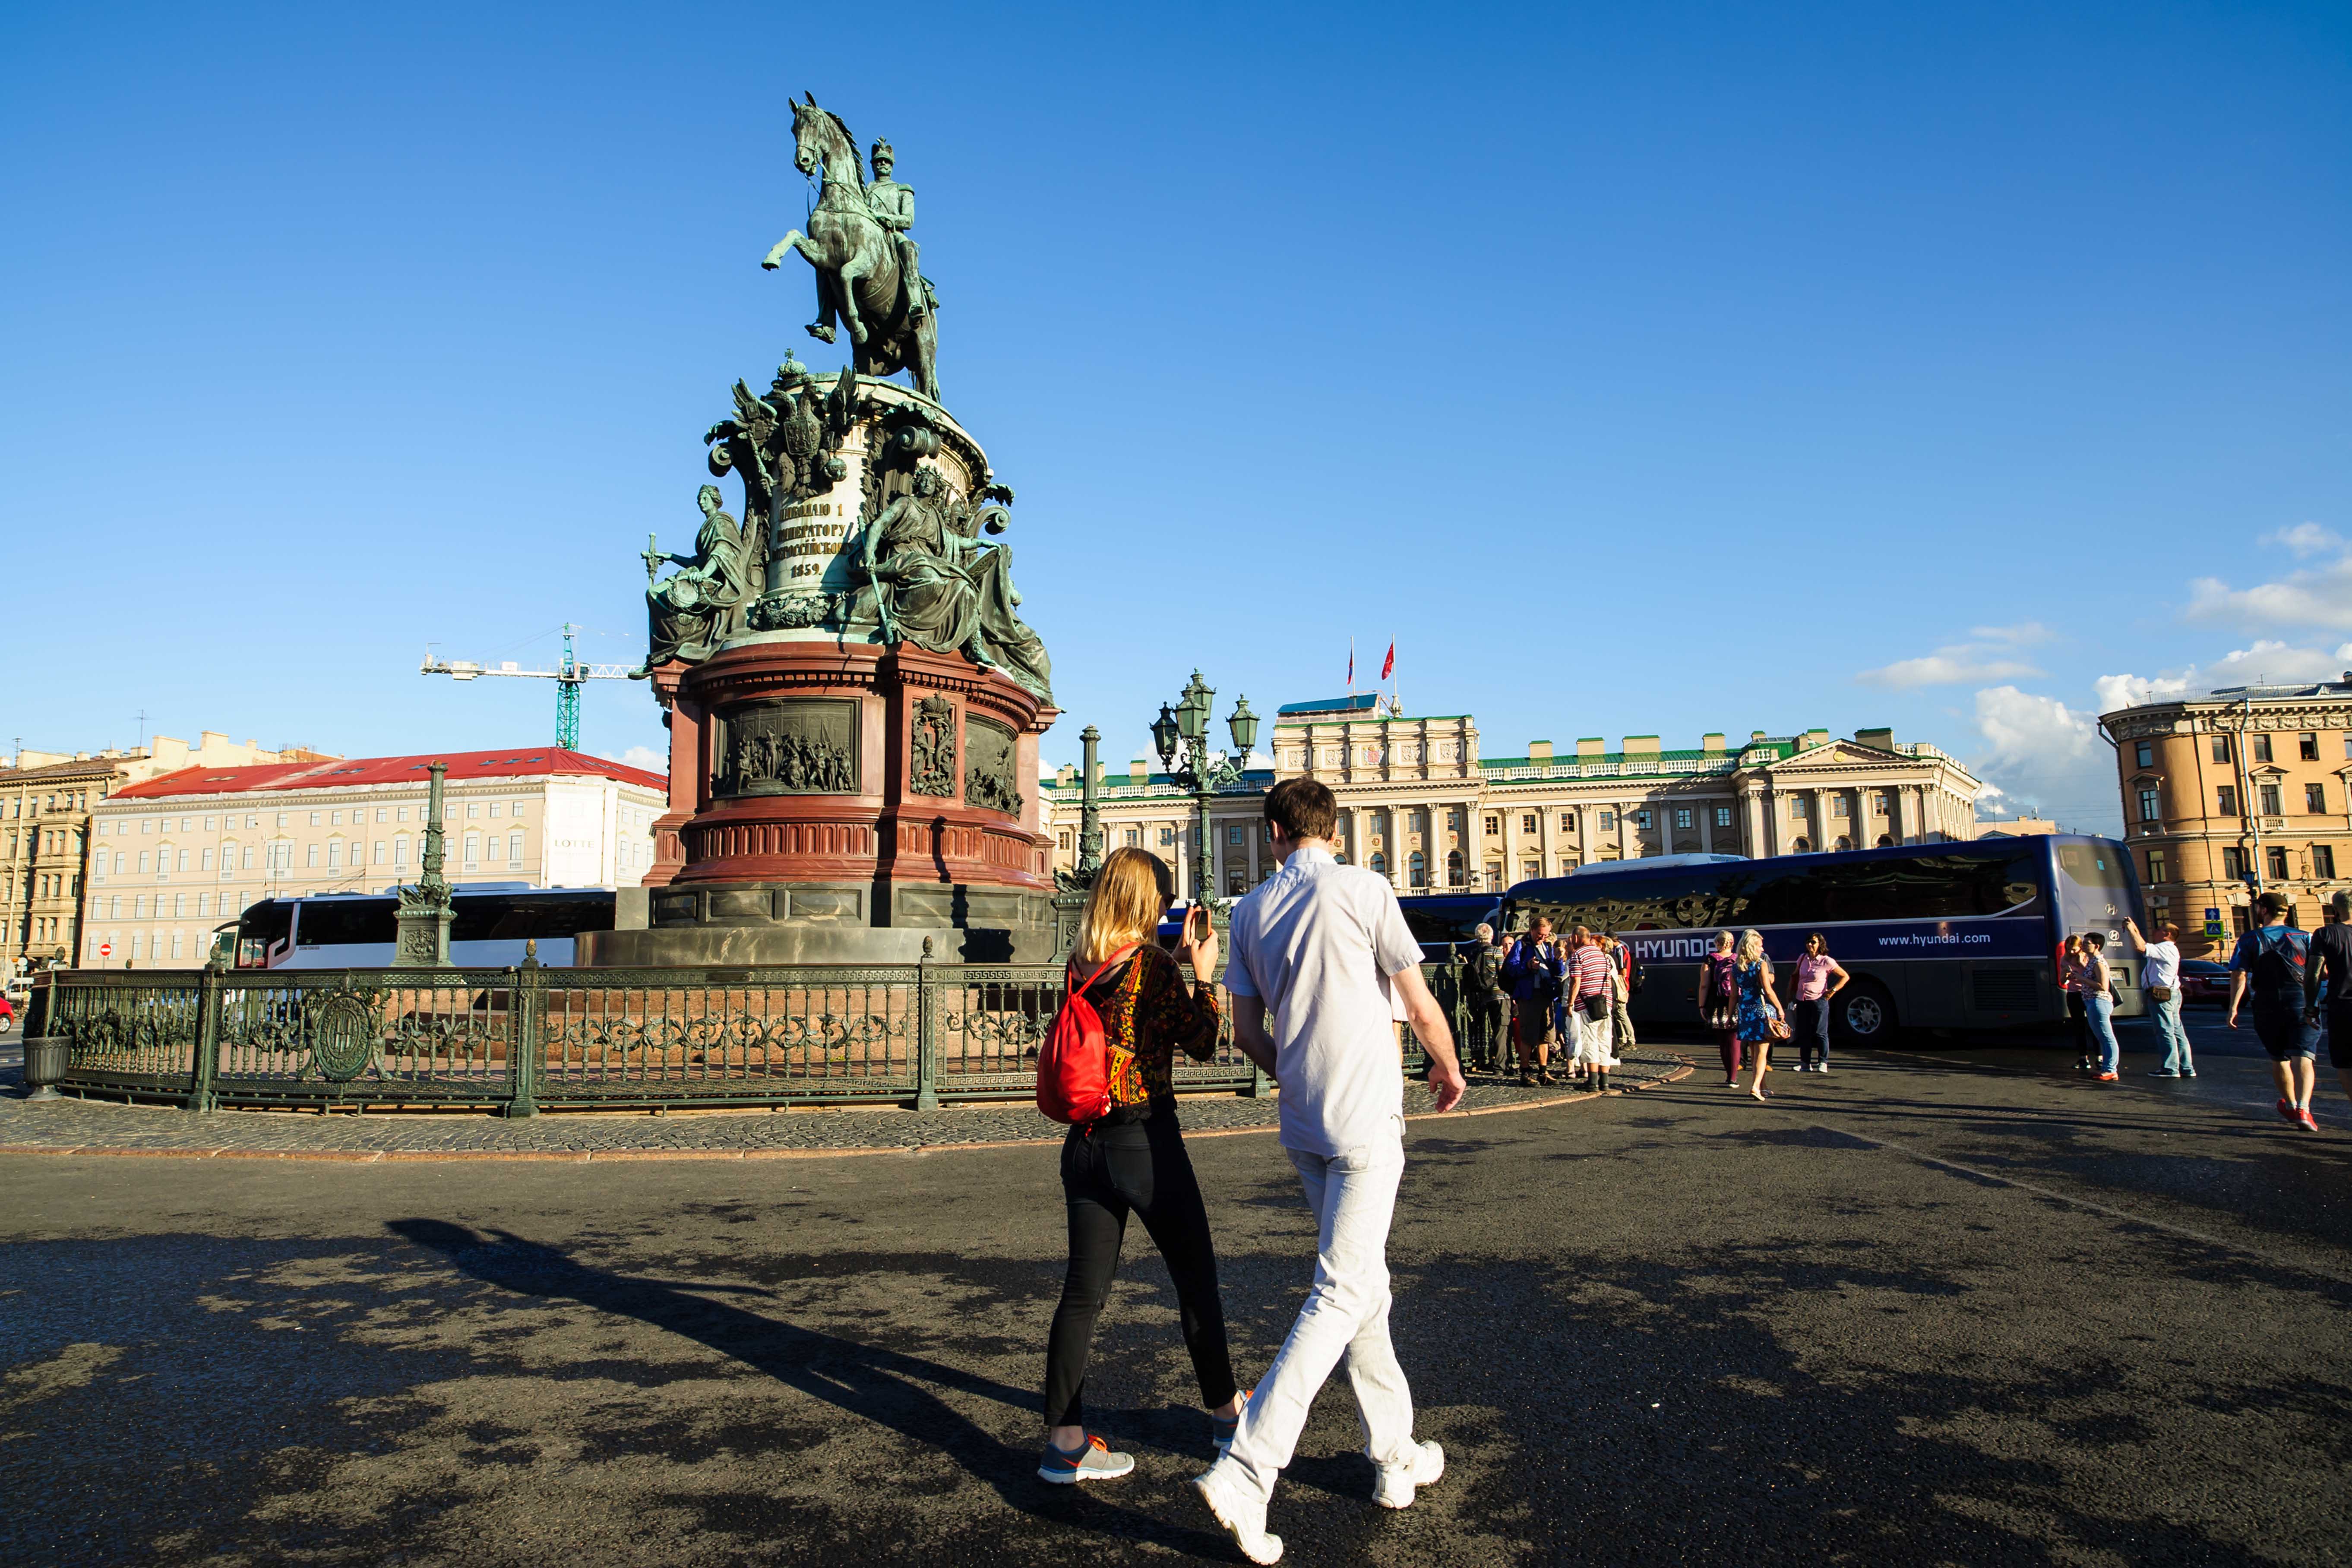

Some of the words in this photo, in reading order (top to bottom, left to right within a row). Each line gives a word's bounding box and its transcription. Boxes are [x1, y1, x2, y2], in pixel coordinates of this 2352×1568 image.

[554, 839, 594, 848] LOTTE
[1878, 933, 1991, 947] www.hyundai.com
[1634, 938, 1717, 958] HYUNDA
